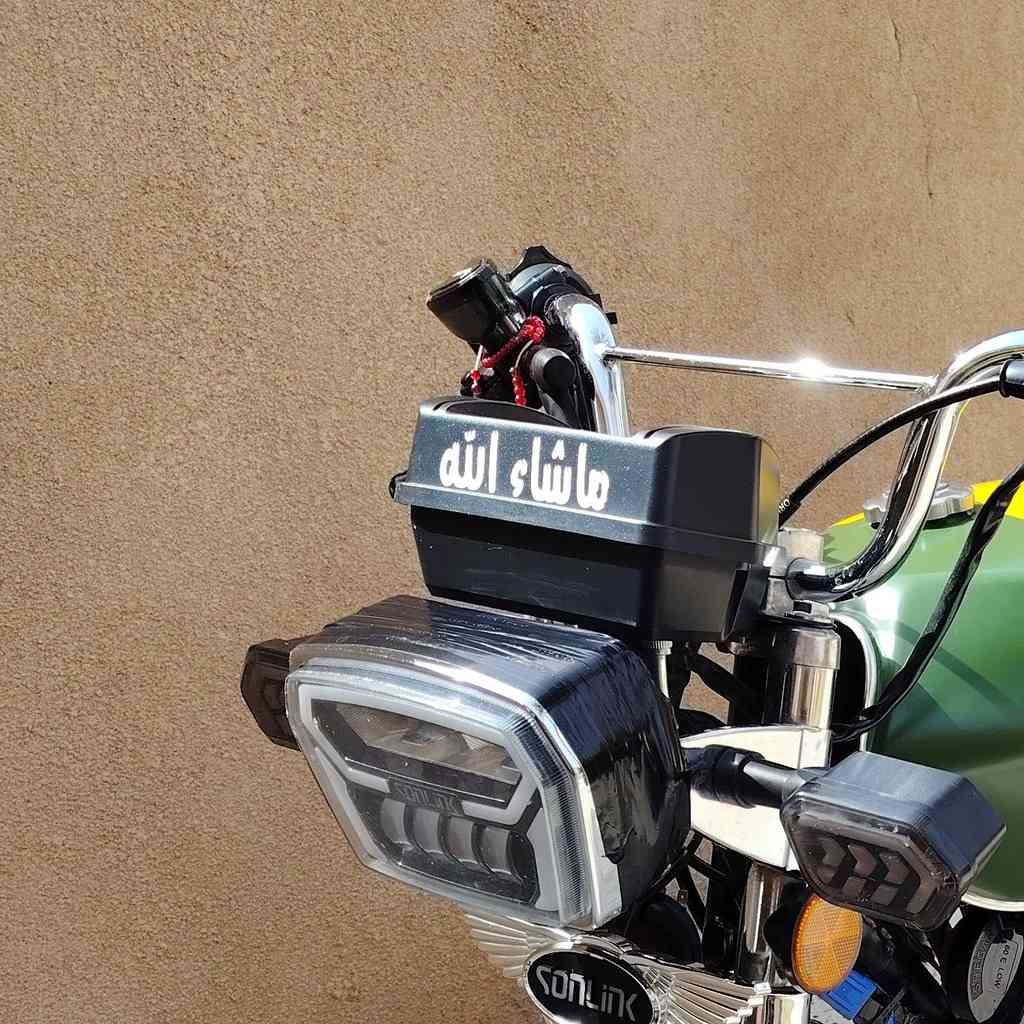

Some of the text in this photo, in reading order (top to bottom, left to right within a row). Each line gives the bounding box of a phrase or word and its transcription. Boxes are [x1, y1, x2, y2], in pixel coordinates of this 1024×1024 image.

[439, 429, 609, 511] ماشاء الله
[535, 964, 638, 1022] SONLINK
